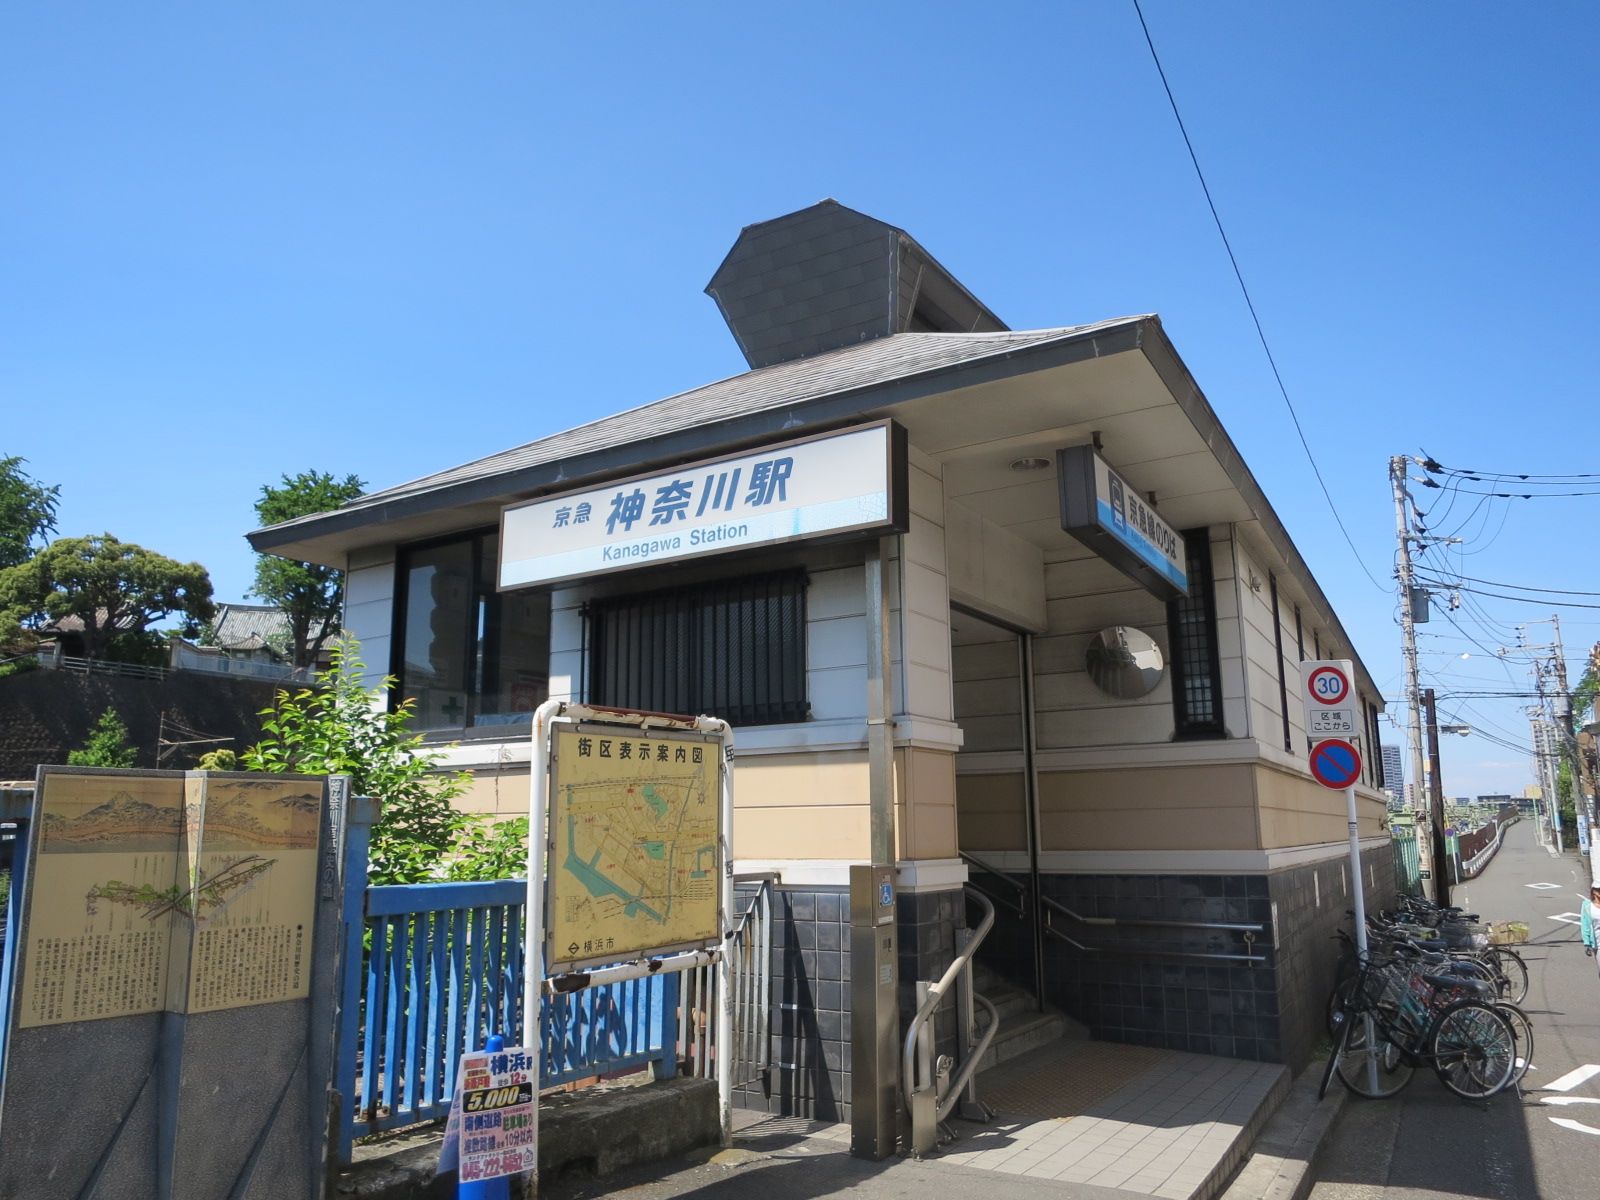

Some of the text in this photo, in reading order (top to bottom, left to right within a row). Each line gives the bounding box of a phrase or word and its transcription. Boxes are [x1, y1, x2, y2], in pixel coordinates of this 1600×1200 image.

[552, 456, 794, 535] 京急 神奈川駅
[1128, 495, 1177, 560] 京急線のりば
[602, 523, 748, 562] Kanagawa Station
[1318, 677, 1340, 694] 30
[1314, 722, 1350, 731] ここから
[1321, 712, 1341, 720] 区域
[578, 737, 703, 764] 街区表示案内図
[584, 937, 614, 953] 横浜市
[467, 1086, 520, 1111] 5,000
